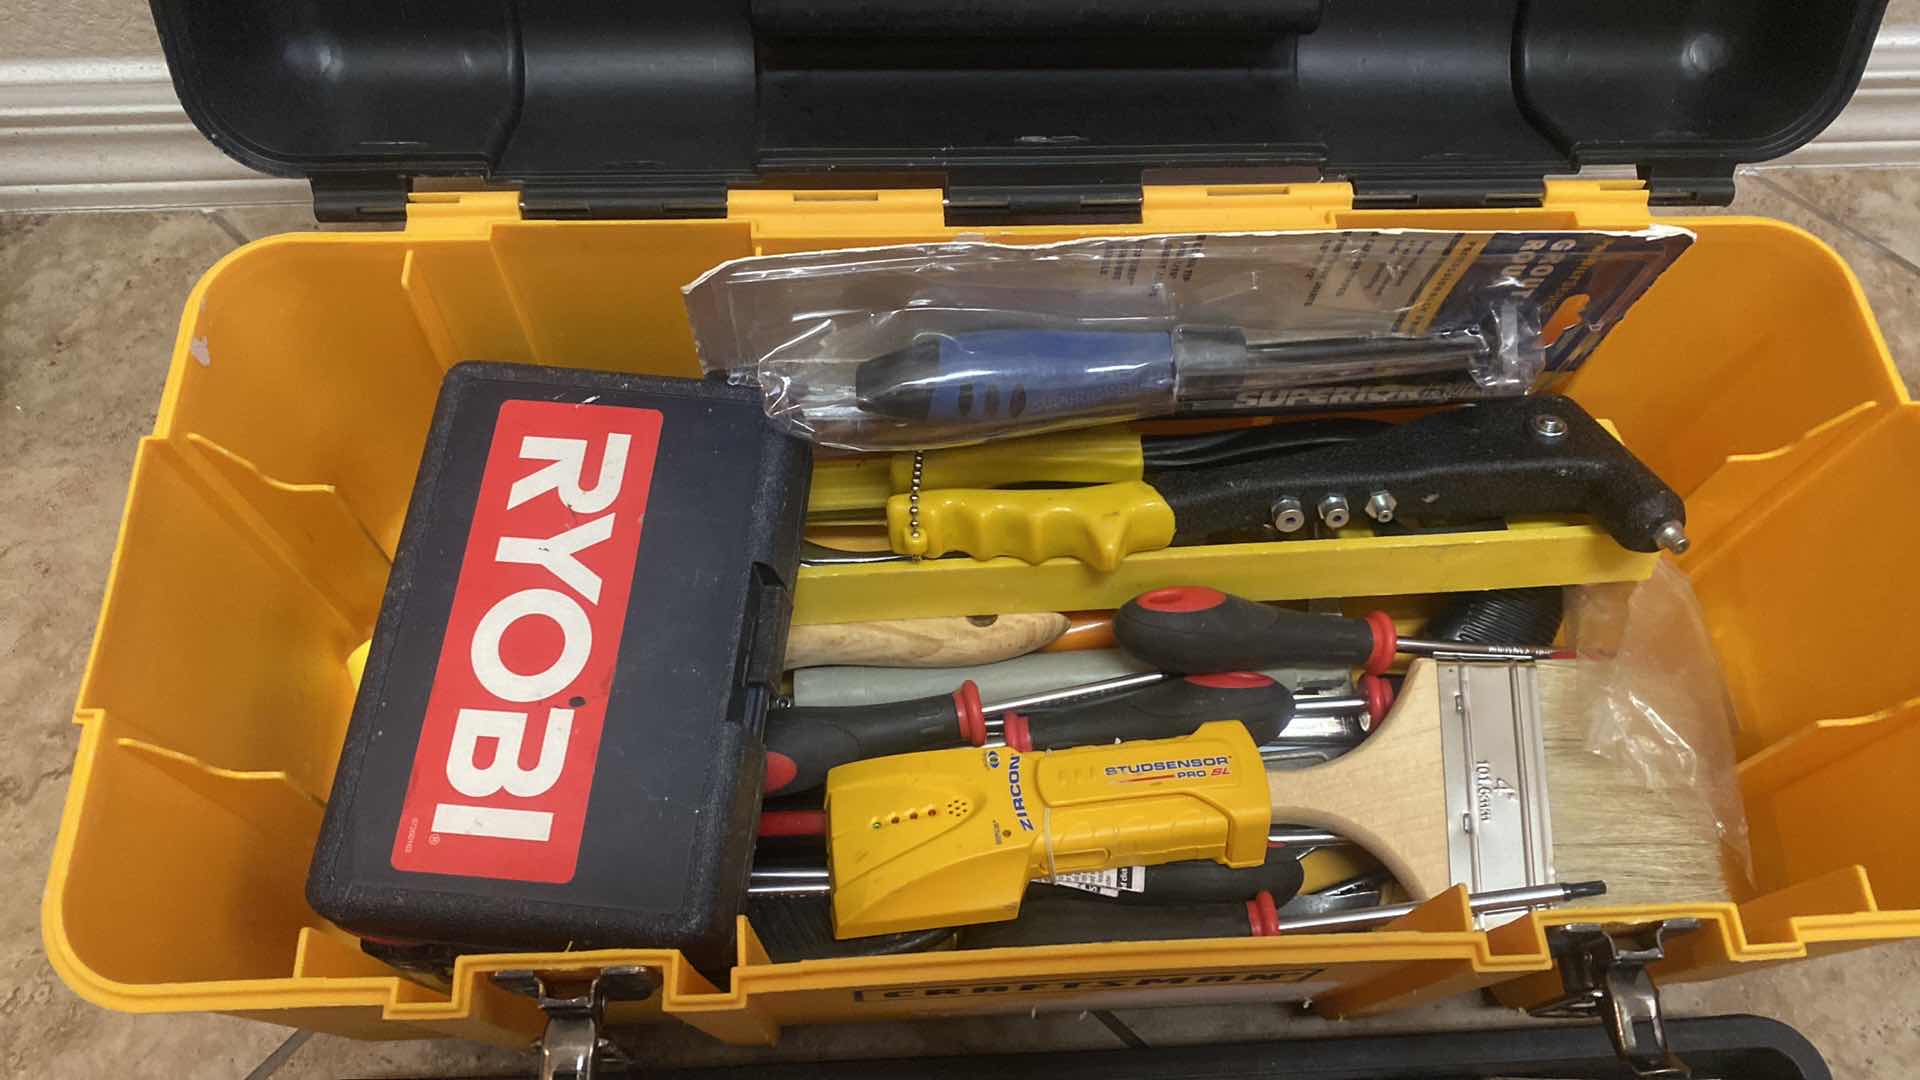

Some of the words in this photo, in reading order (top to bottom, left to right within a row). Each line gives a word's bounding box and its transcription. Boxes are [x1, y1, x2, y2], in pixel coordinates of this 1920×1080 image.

[430, 432, 632, 842] RYOBI
[1104, 756, 1230, 776] STUDSENSOR
[1177, 769, 1207, 779] PRO
[1210, 767, 1231, 776] SL
[1008, 755, 1035, 832] ZIRCON
[882, 971, 1287, 1000] CRAFTSMAN
